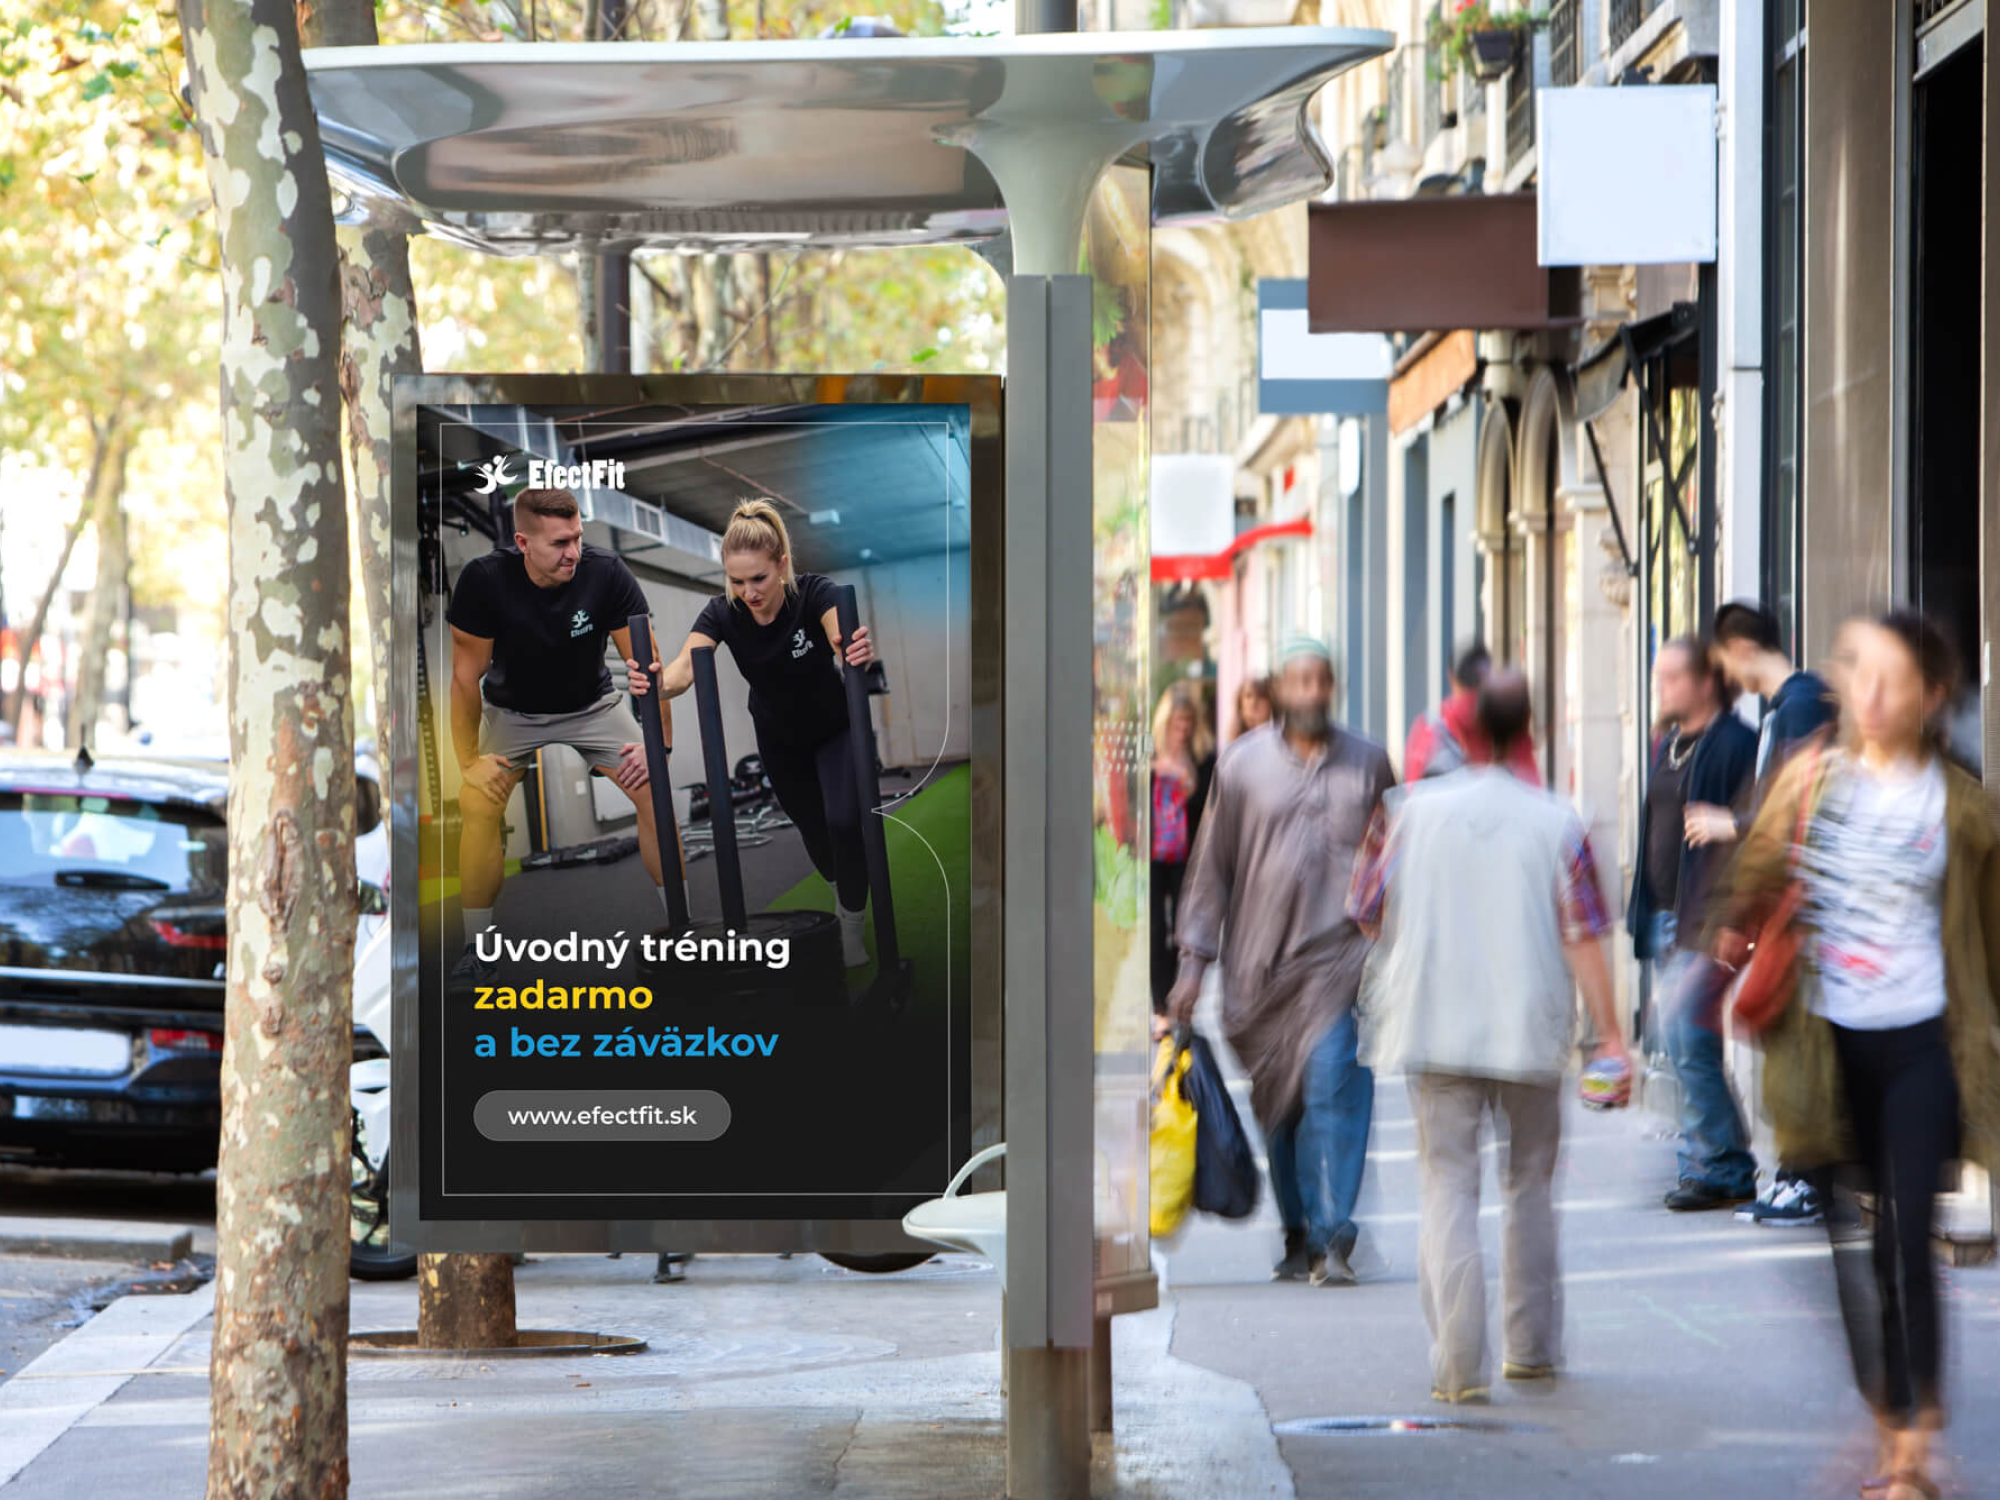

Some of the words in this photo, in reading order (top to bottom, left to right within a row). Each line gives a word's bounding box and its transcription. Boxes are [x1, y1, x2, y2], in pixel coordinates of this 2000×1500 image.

[529, 459, 625, 489] EfectFit
[475, 925, 630, 969] Úvodný
[640, 929, 790, 969] tréning
[474, 978, 653, 1009] zadarmo
[474, 1034, 496, 1057] a
[511, 1026, 582, 1057] bez
[593, 1026, 779, 1057] záväzkov
[507, 1105, 698, 1125] www.efectfit.sk
